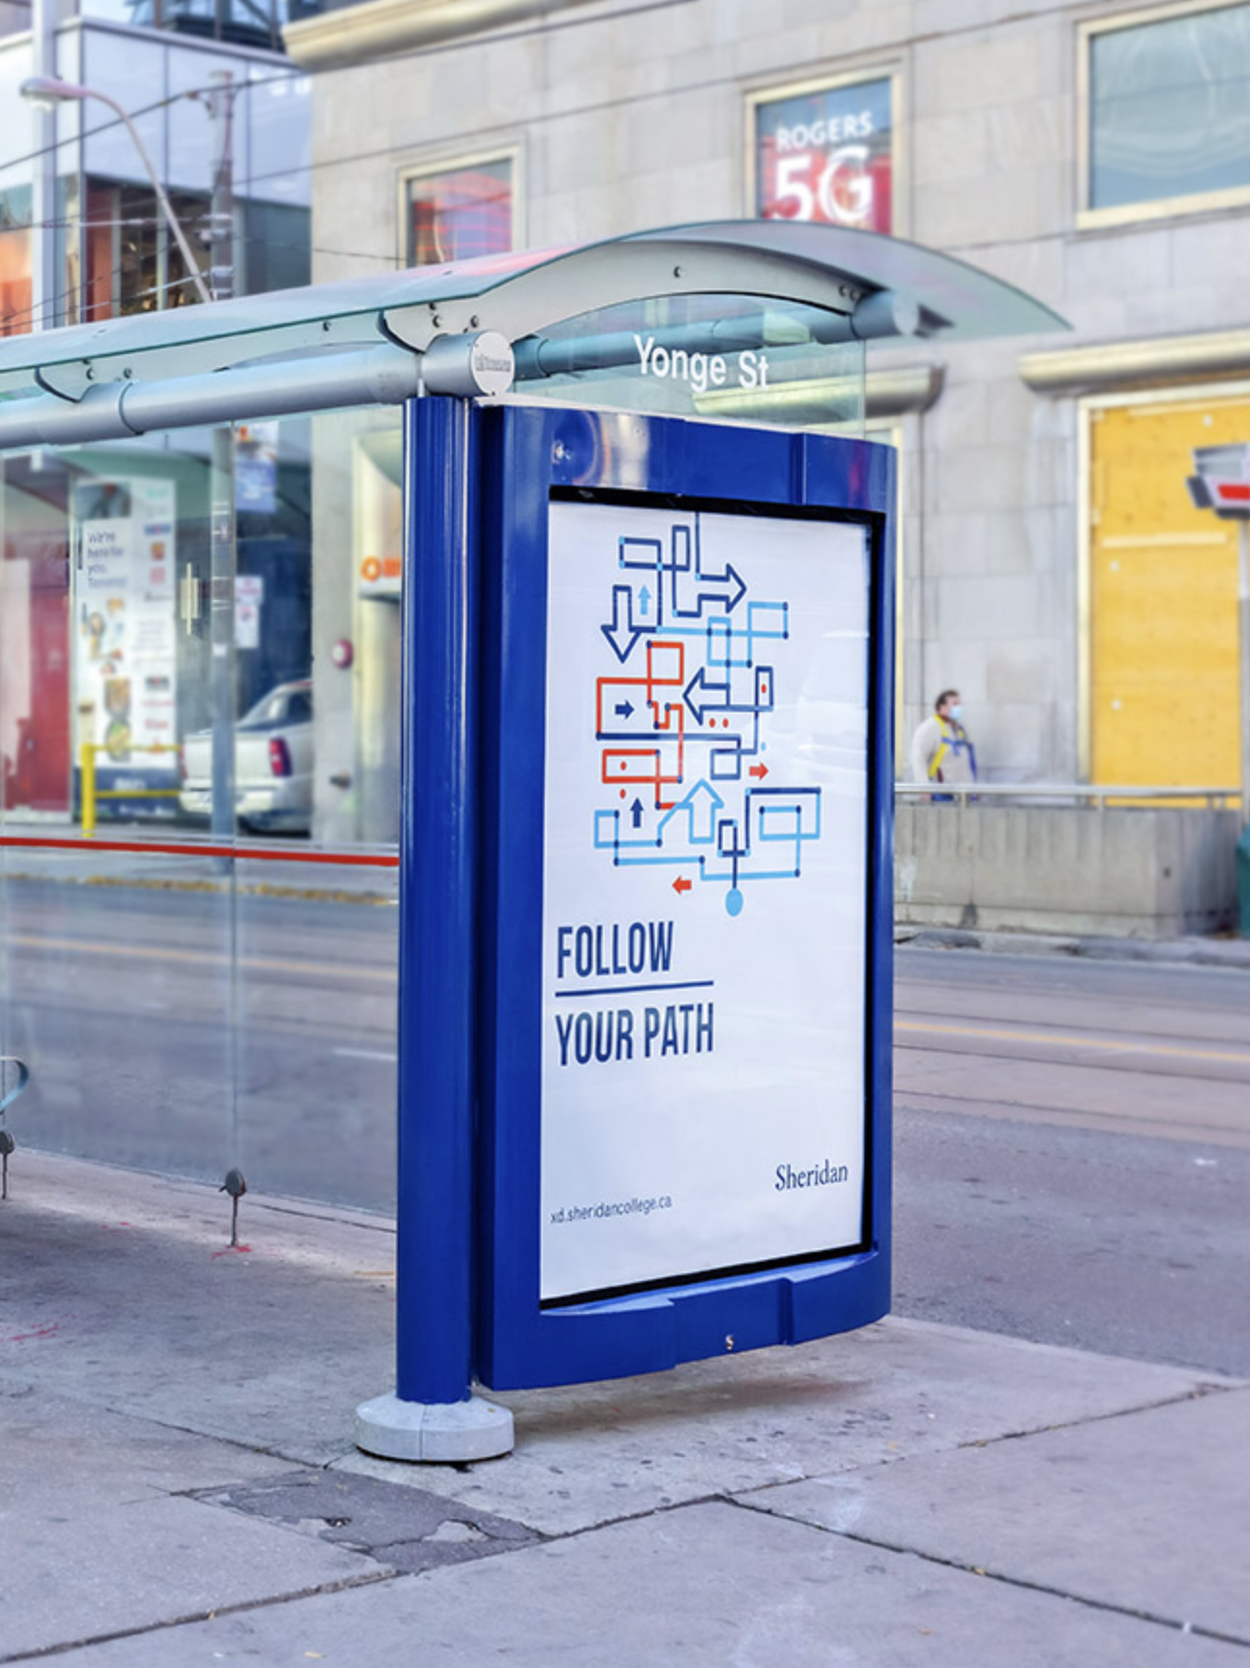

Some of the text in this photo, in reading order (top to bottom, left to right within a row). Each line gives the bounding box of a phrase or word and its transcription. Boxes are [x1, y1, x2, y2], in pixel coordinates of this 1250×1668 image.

[776, 111, 873, 152] ROGERS
[775, 145, 873, 222] 5G
[633, 334, 769, 393] Yonge St
[557, 920, 674, 979] FOLLOW
[554, 1002, 714, 1067] YOUR PATH
[774, 1159, 849, 1191] Sheridan
[550, 1194, 673, 1224] xd.sheridancollege.ca
